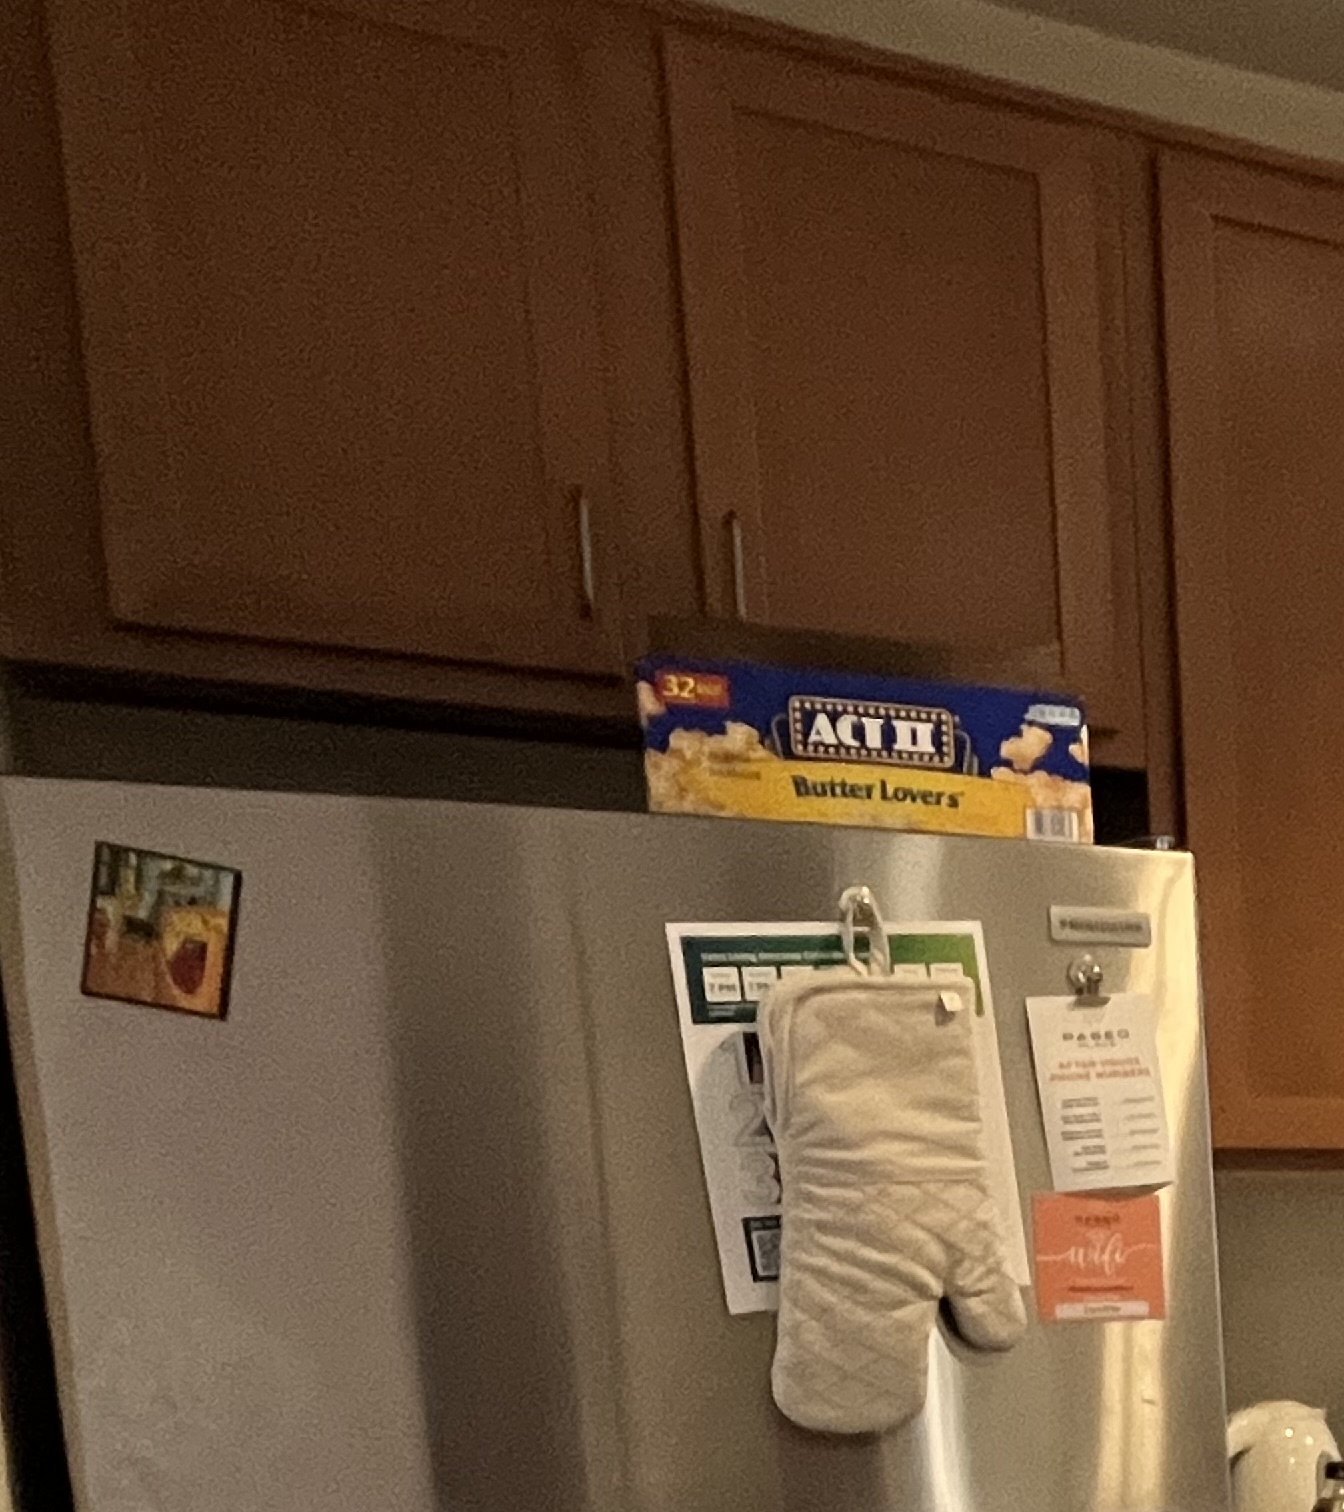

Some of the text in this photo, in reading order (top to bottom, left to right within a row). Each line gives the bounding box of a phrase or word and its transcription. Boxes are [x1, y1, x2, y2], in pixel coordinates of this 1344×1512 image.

[663, 674, 696, 698] 32
[808, 712, 936, 753] ACT II
[791, 774, 960, 808] Butter Lovers
